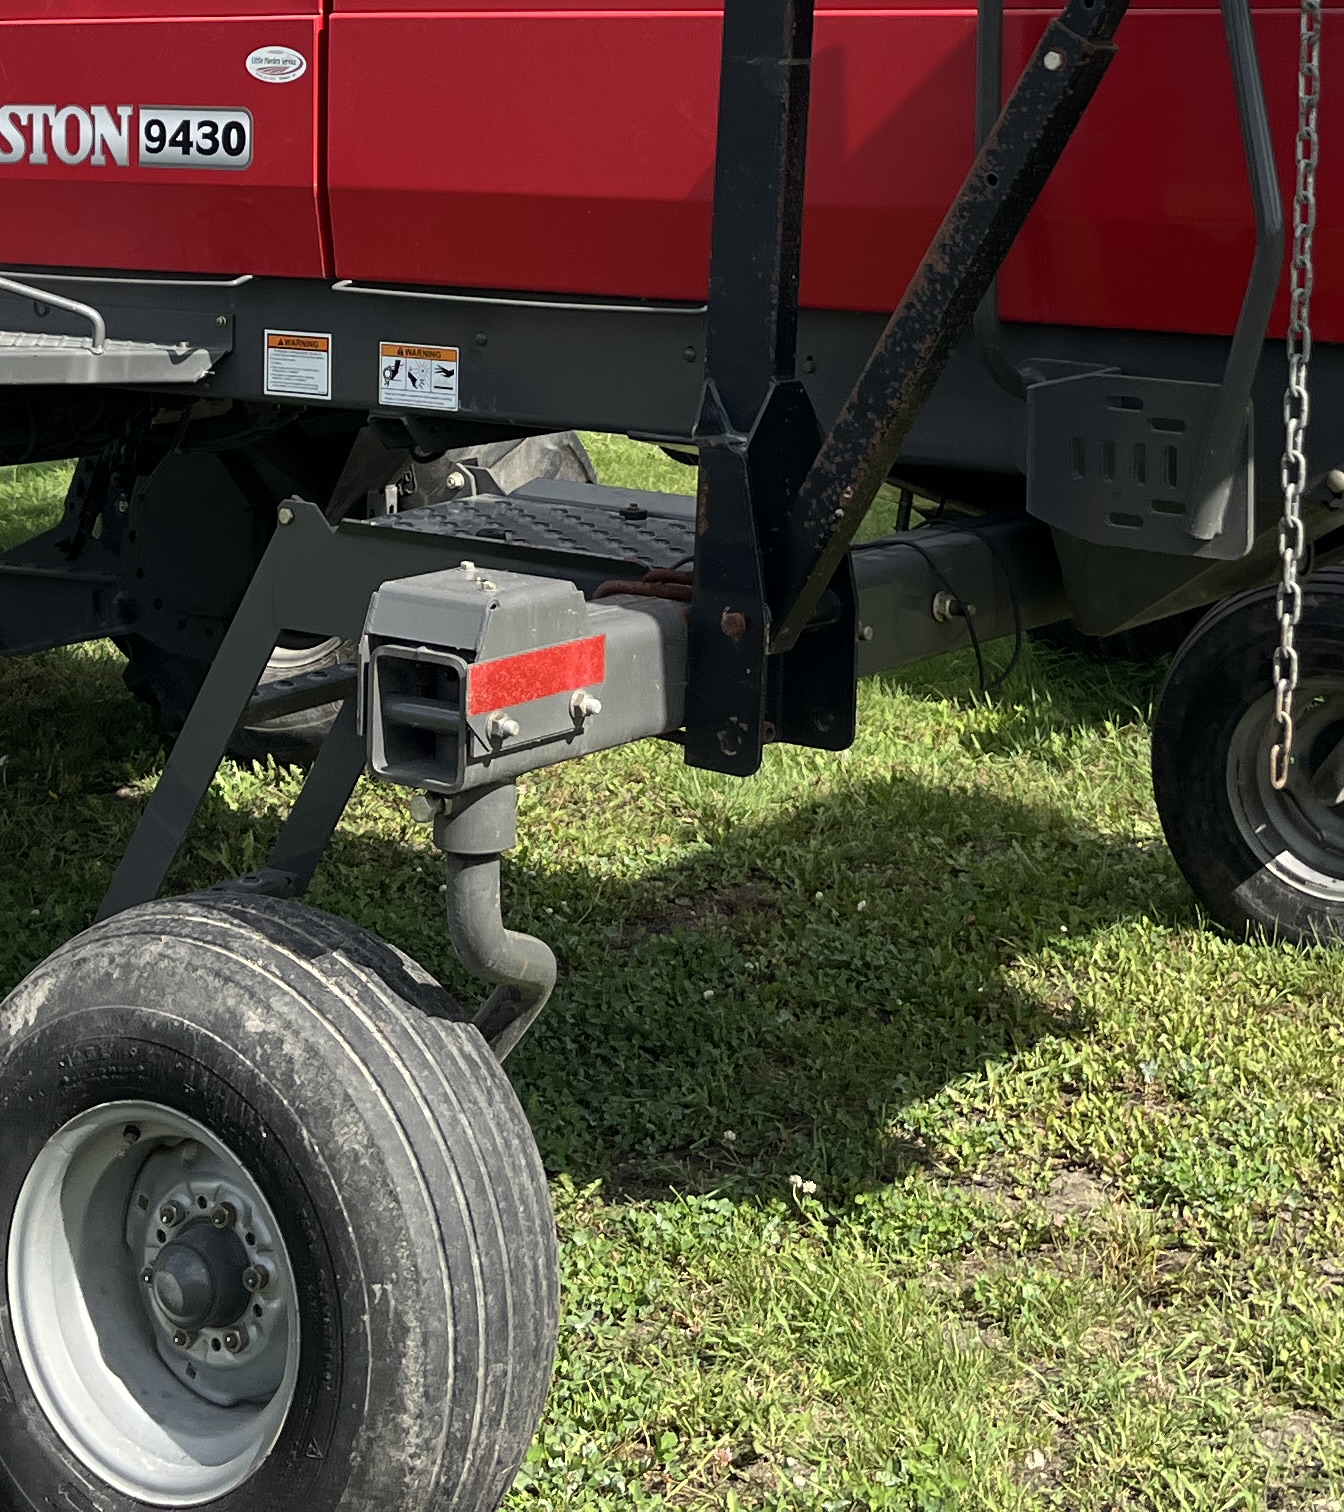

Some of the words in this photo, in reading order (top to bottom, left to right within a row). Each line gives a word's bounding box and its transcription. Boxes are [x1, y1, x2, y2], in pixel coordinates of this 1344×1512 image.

[144, 119, 246, 156] 9430
[284, 338, 319, 348] WARNING
[405, 348, 442, 358] WARNING
